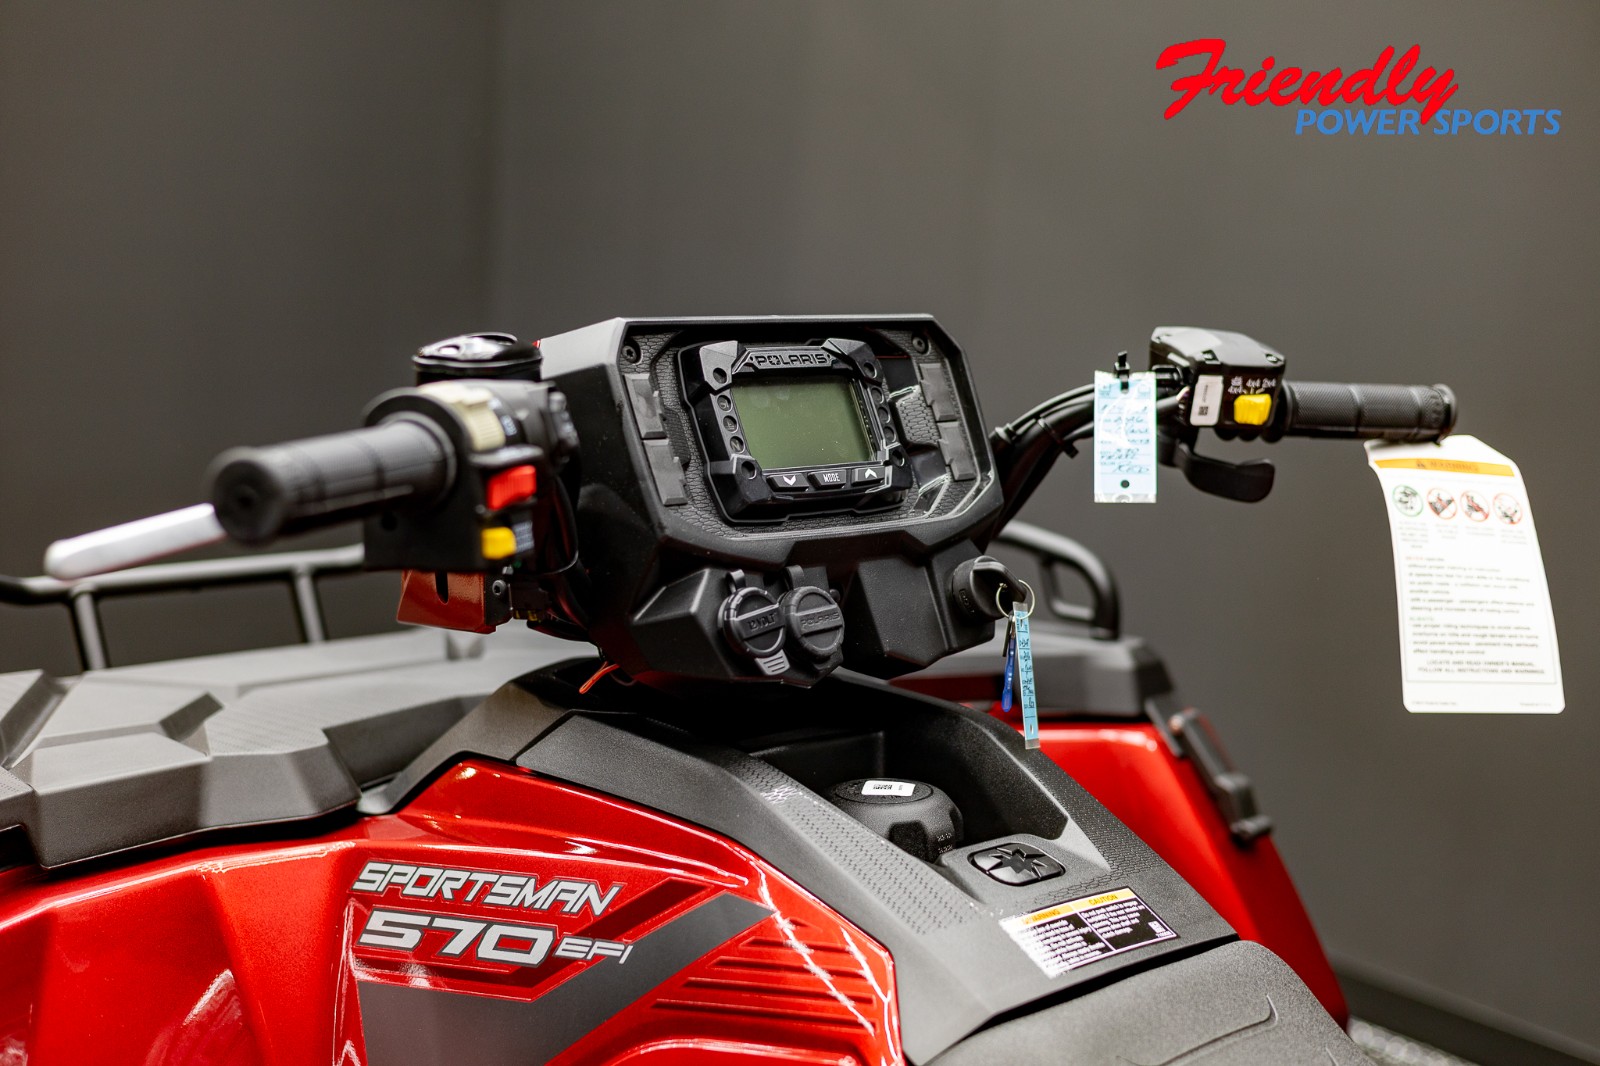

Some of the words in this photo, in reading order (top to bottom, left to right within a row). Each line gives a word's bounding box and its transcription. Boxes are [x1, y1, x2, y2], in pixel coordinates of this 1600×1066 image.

[755, 353, 827, 366] POLARIS
[822, 472, 840, 482] MODE
[801, 611, 840, 629] POLARIS
[351, 861, 623, 917] SPORTSMAN
[1088, 894, 1118, 906] CAUTION
[357, 908, 557, 968] 570
[553, 936, 634, 965] EFI
